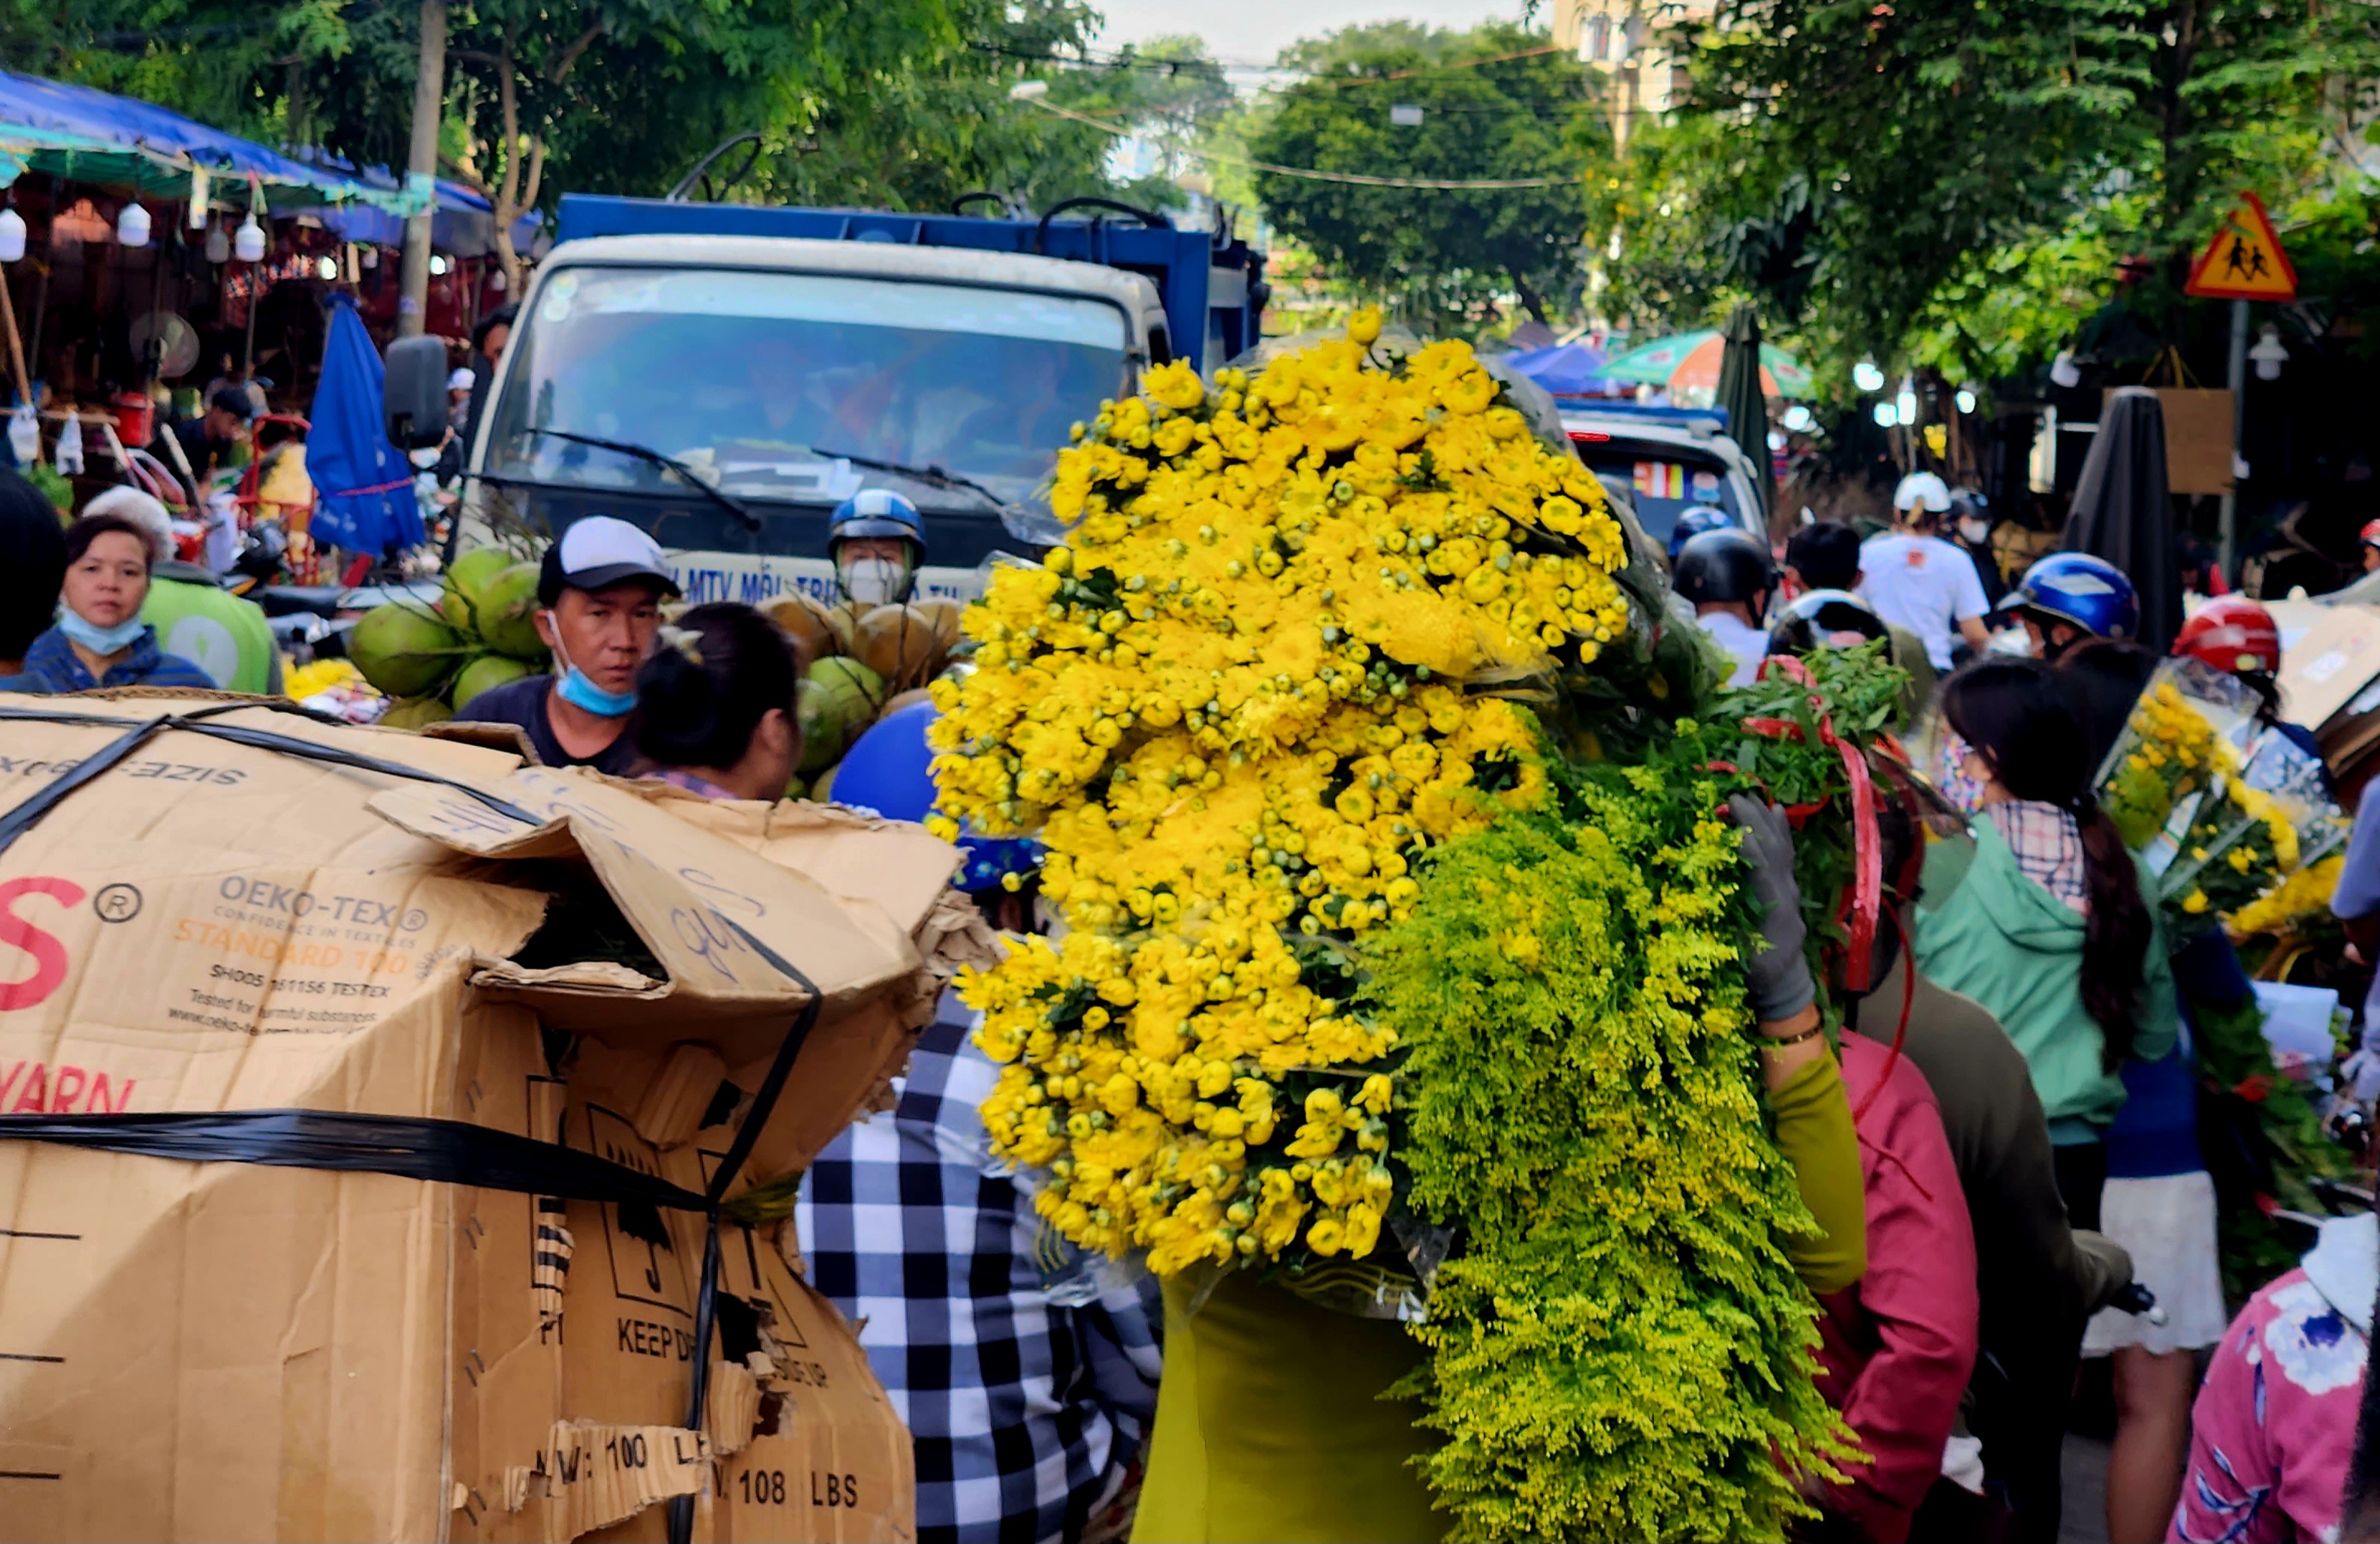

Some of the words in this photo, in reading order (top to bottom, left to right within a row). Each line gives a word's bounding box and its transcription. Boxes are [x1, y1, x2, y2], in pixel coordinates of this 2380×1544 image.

[687, 568, 733, 603] MTV
[174, 918, 342, 968] STANDARD
[355, 950, 409, 975] 100
[618, 1317, 672, 1358] KEEP
[606, 1433, 648, 1471] 100
[738, 1469, 786, 1505] 108
[811, 1470, 858, 1509] LBS
